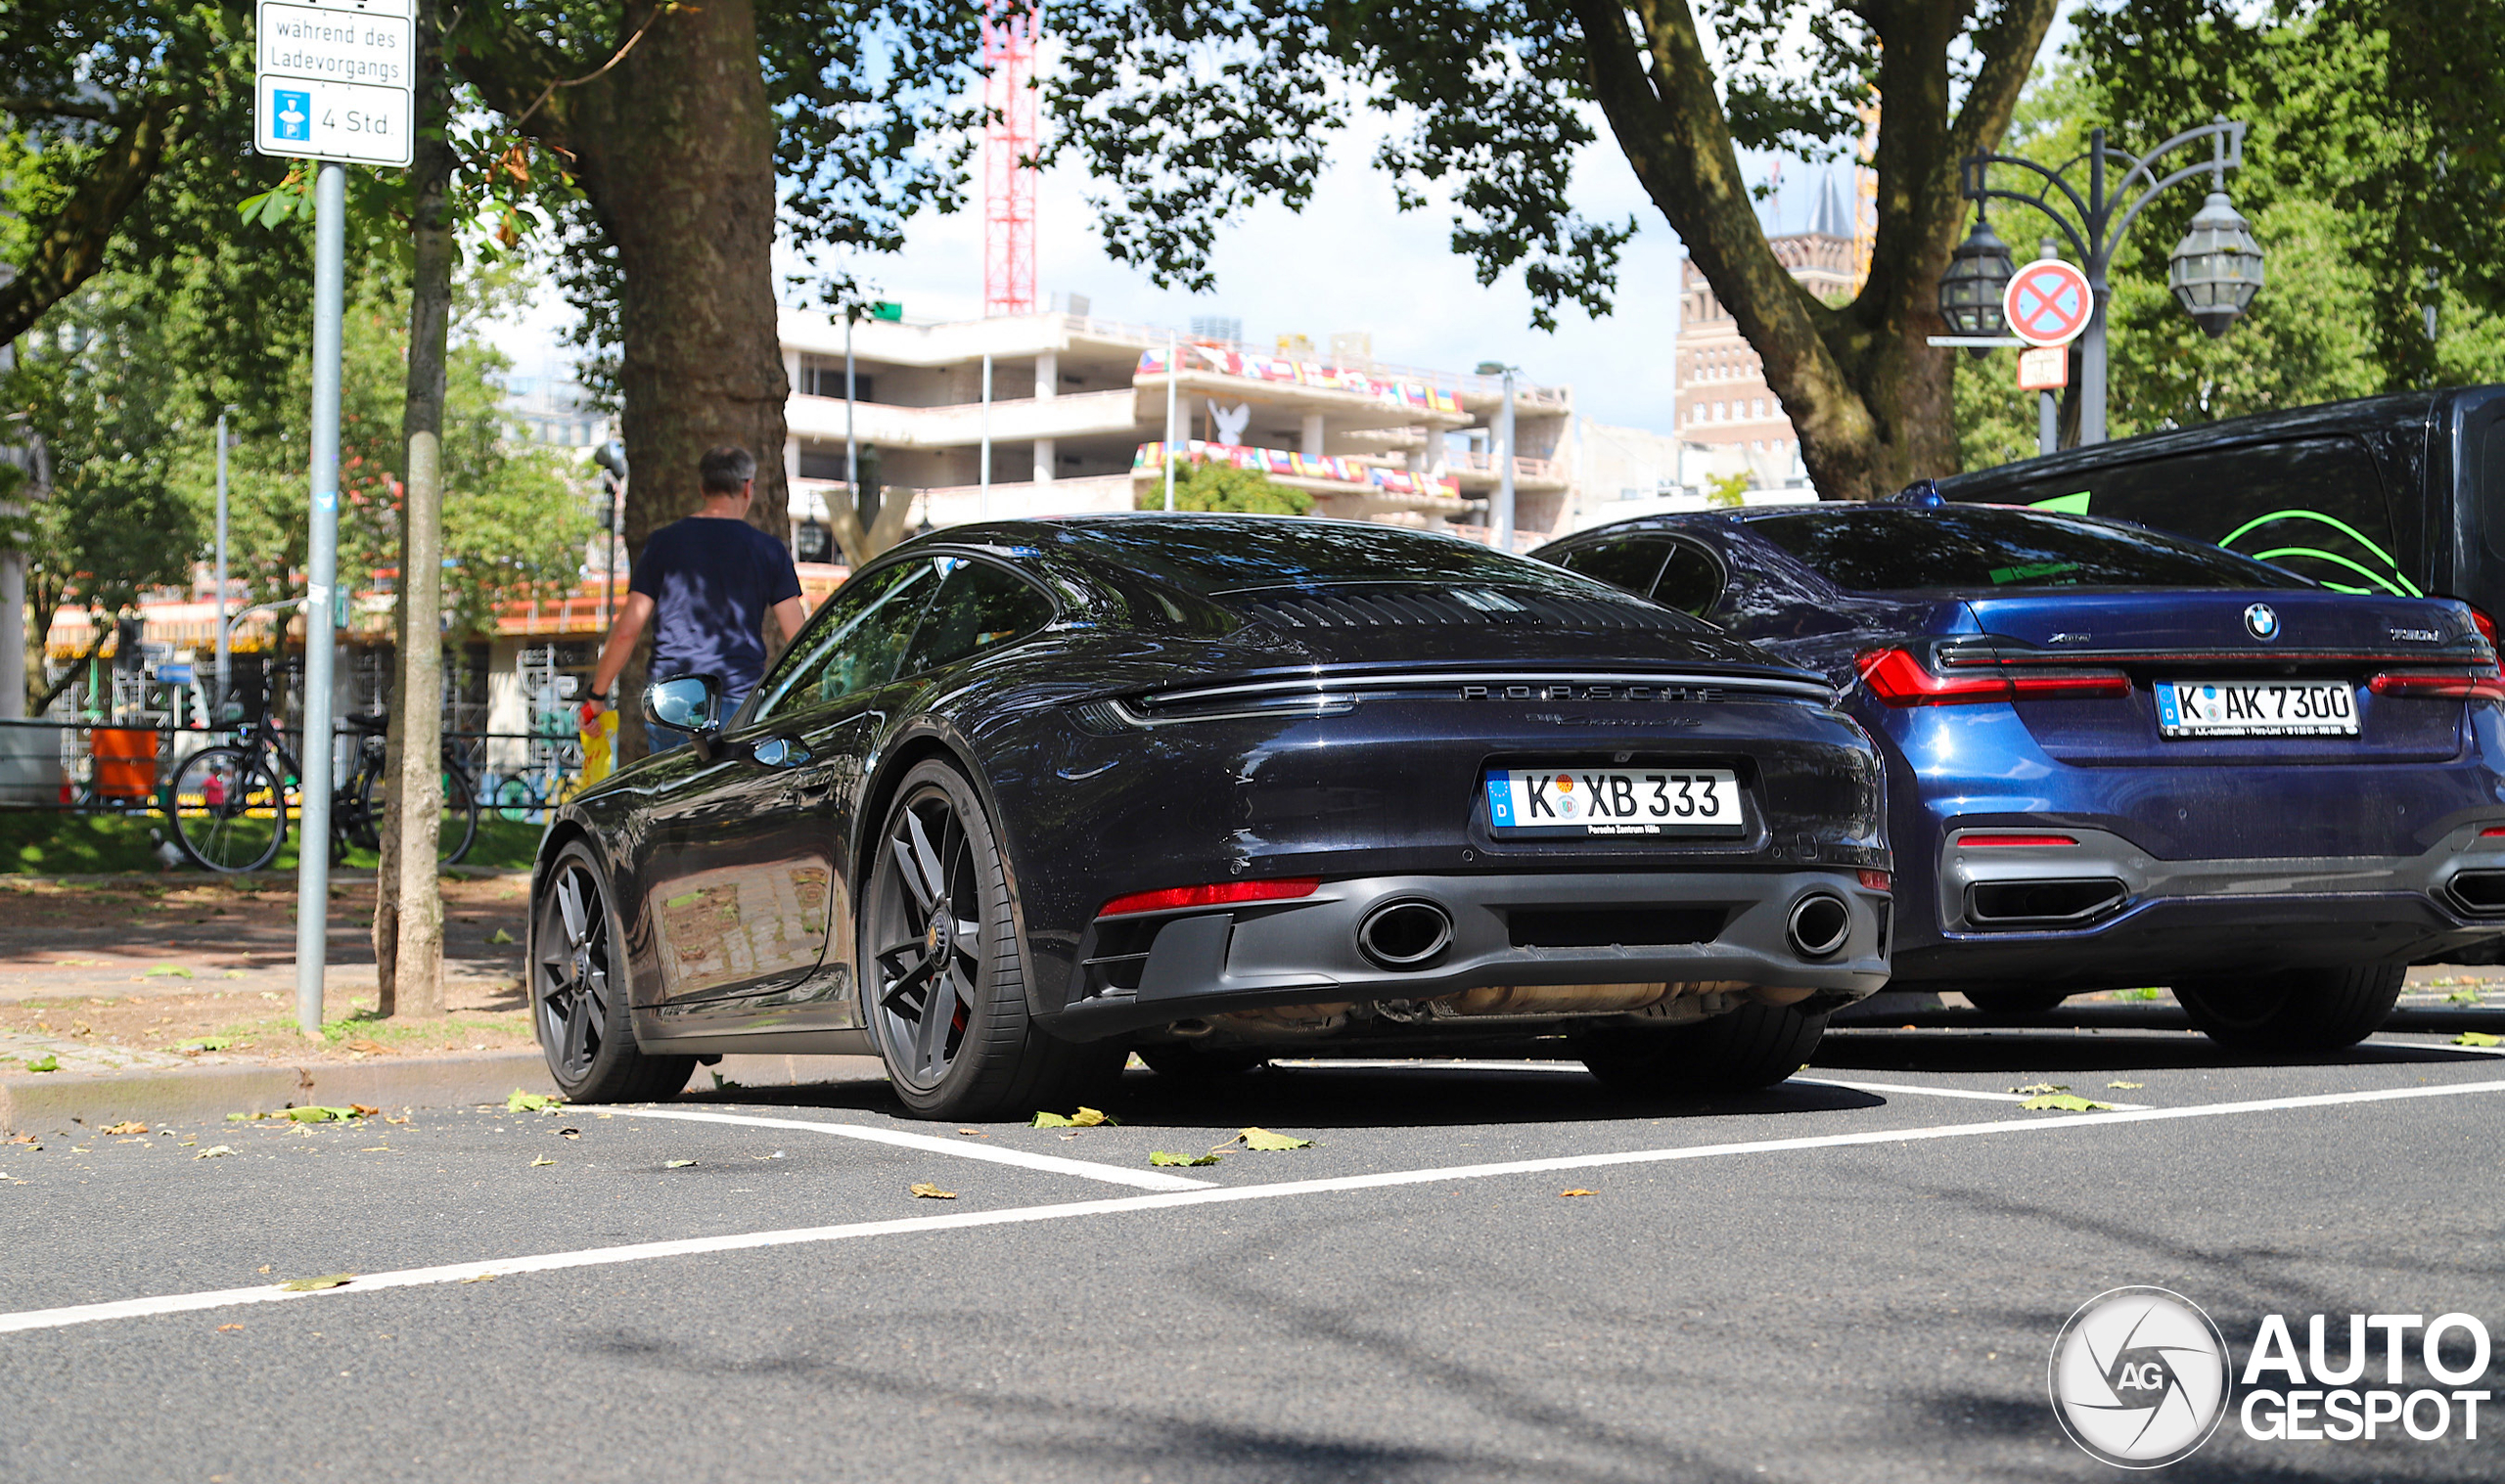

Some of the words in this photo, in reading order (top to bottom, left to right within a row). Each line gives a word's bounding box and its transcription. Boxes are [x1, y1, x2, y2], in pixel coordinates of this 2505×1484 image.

[277, 18, 354, 45] während
[365, 27, 396, 48] des
[272, 46, 399, 82] Ladevorgangs
[322, 108, 336, 129] 4
[346, 111, 393, 135] Std.
[1459, 685, 1725, 702] PORSCHE
[2178, 686, 2203, 719] K
[2225, 686, 2266, 719] AK
[2268, 686, 2350, 718] 7300
[2165, 708, 2174, 720] D
[1496, 803, 1507, 817] D
[1526, 775, 1556, 818] K
[1582, 775, 1638, 818] XB
[1645, 775, 1720, 818] 333
